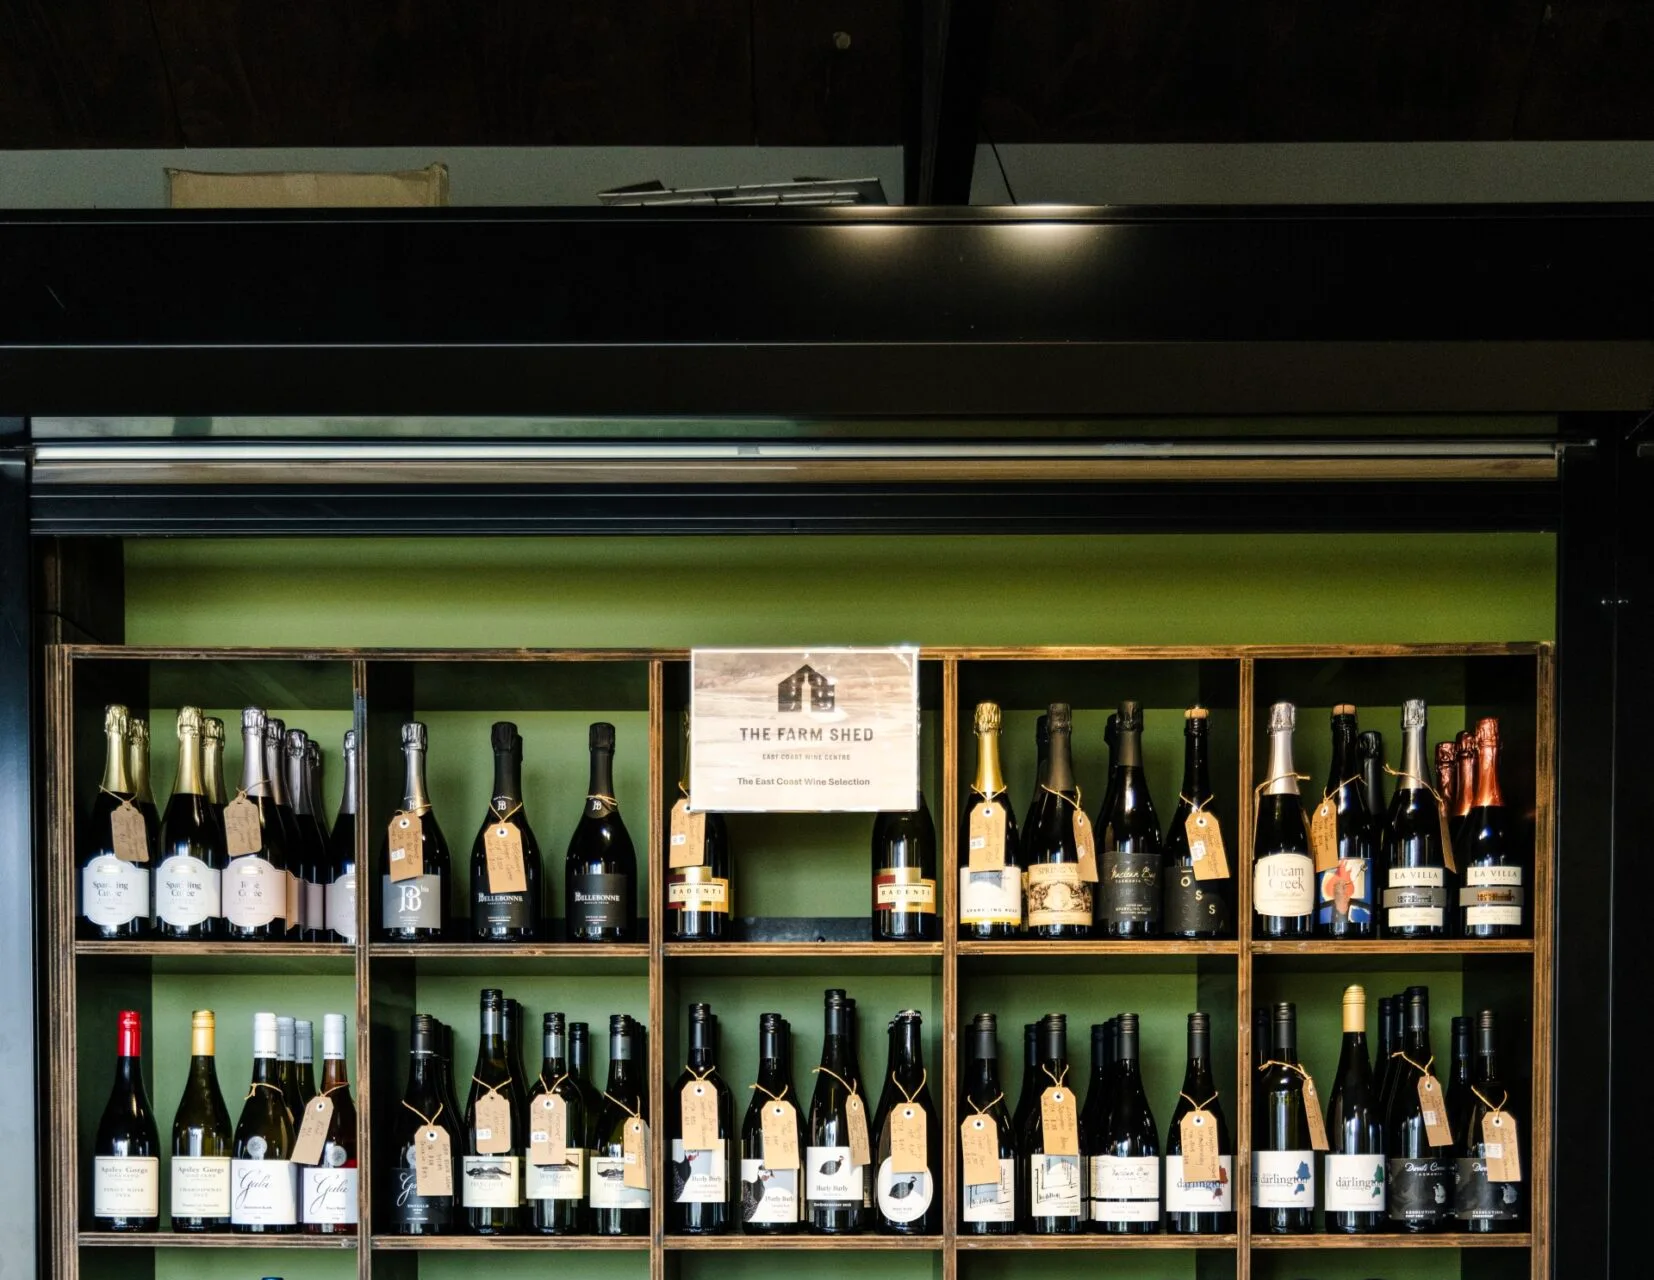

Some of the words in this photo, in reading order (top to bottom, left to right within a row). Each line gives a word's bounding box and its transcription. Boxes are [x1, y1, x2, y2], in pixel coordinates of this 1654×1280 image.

[740, 727, 771, 742] THE
[777, 727, 823, 742] FARM
[829, 727, 874, 742] SHED
[762, 753, 779, 761] EAST
[781, 753, 803, 761] COAST
[805, 753, 822, 761] WINE
[824, 753, 851, 761] CENTRE
[737, 777, 753, 786] The
[755, 777, 775, 786] East
[776, 777, 803, 786] Coast
[804, 777, 827, 786] Wine
[828, 777, 870, 786] Selection
[1394, 871, 1406, 879] LA
[1410, 871, 1438, 879] VILLA
[1474, 870, 1485, 878] LA
[1491, 870, 1517, 879] VILLA
[478, 892, 523, 903] BELLEBONNE
[574, 892, 620, 902] BELLEBONNE
[1261, 1173, 1308, 1186] darlington
